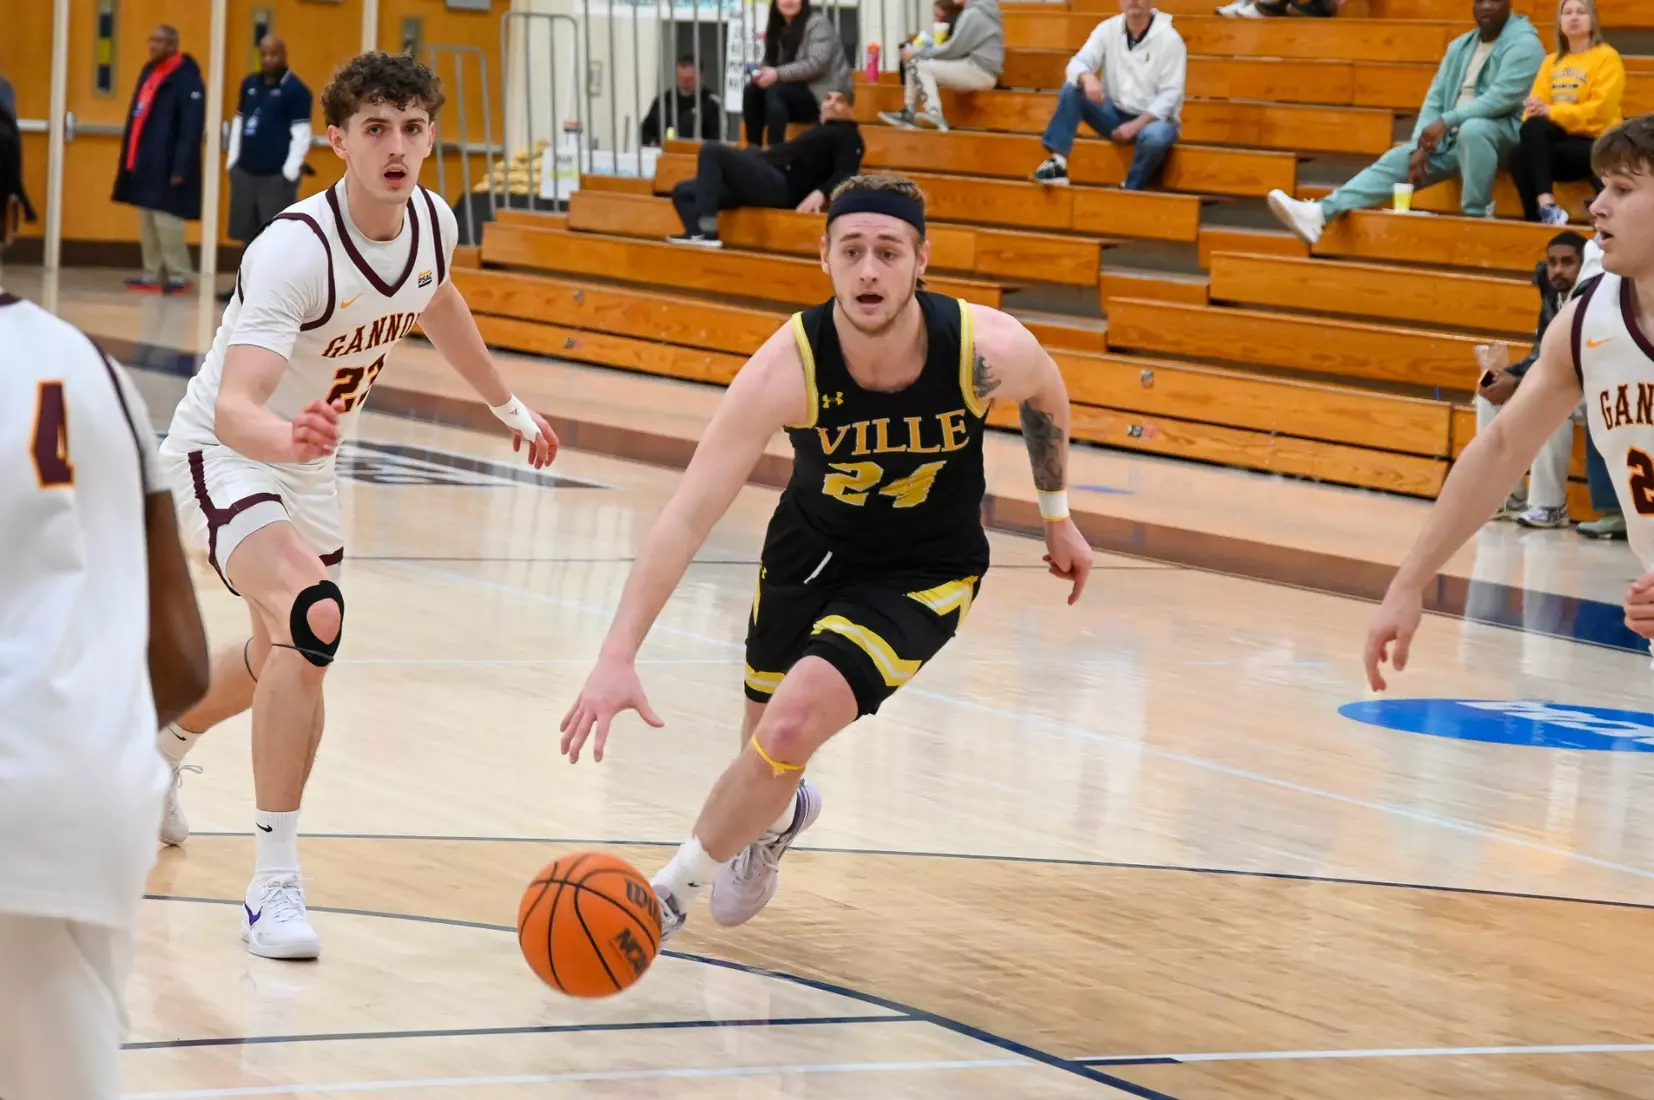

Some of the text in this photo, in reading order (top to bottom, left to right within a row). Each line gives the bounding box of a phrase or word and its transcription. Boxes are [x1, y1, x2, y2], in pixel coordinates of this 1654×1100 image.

[321, 312, 420, 358] GANNO
[815, 408, 970, 456] VILLE
[821, 459, 947, 509] 24
